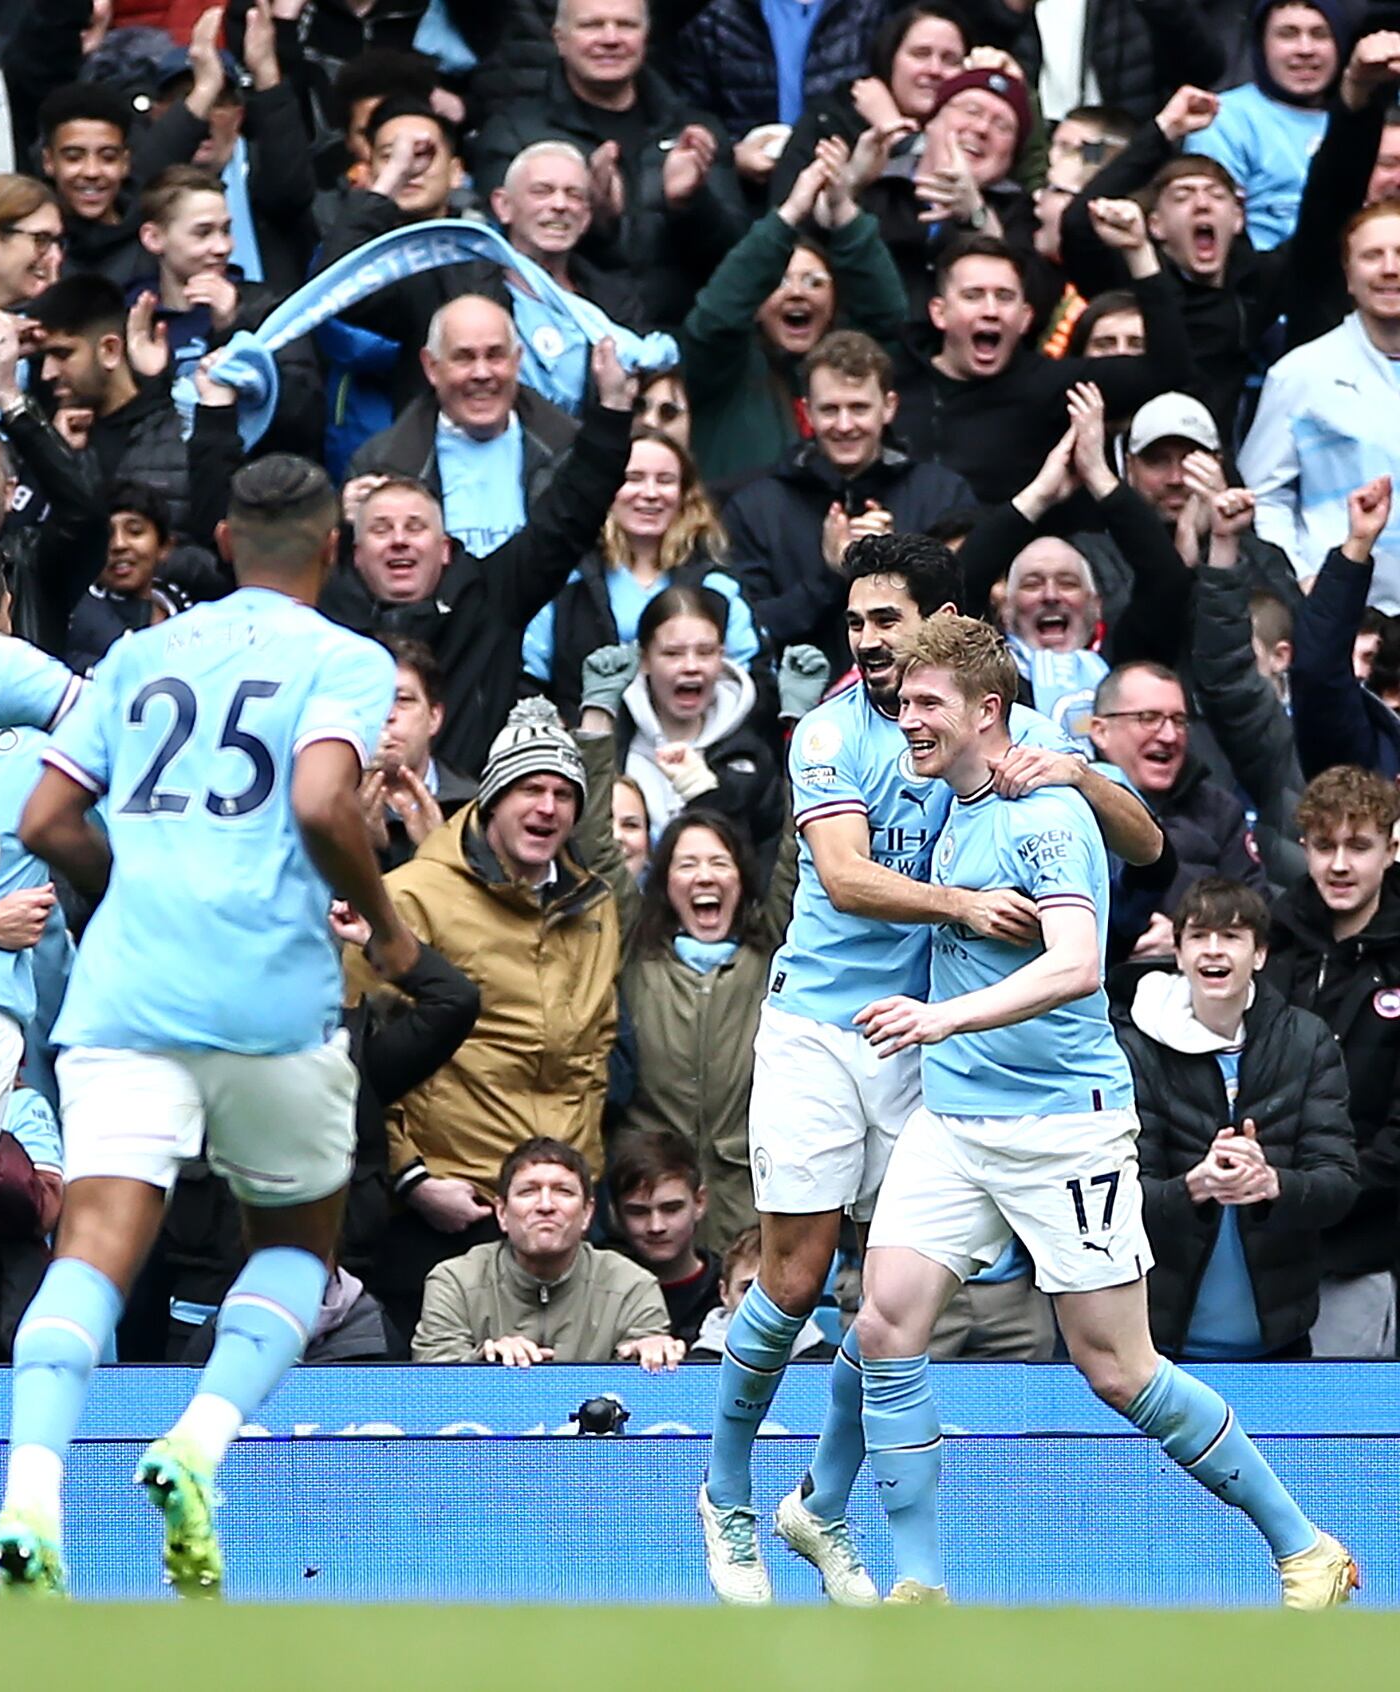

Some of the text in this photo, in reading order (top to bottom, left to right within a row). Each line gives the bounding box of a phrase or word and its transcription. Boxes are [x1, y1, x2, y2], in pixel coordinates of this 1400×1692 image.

[118, 676, 282, 817] 25
[1016, 829, 1073, 862] NEXEN
[1066, 1170, 1121, 1235] 17
